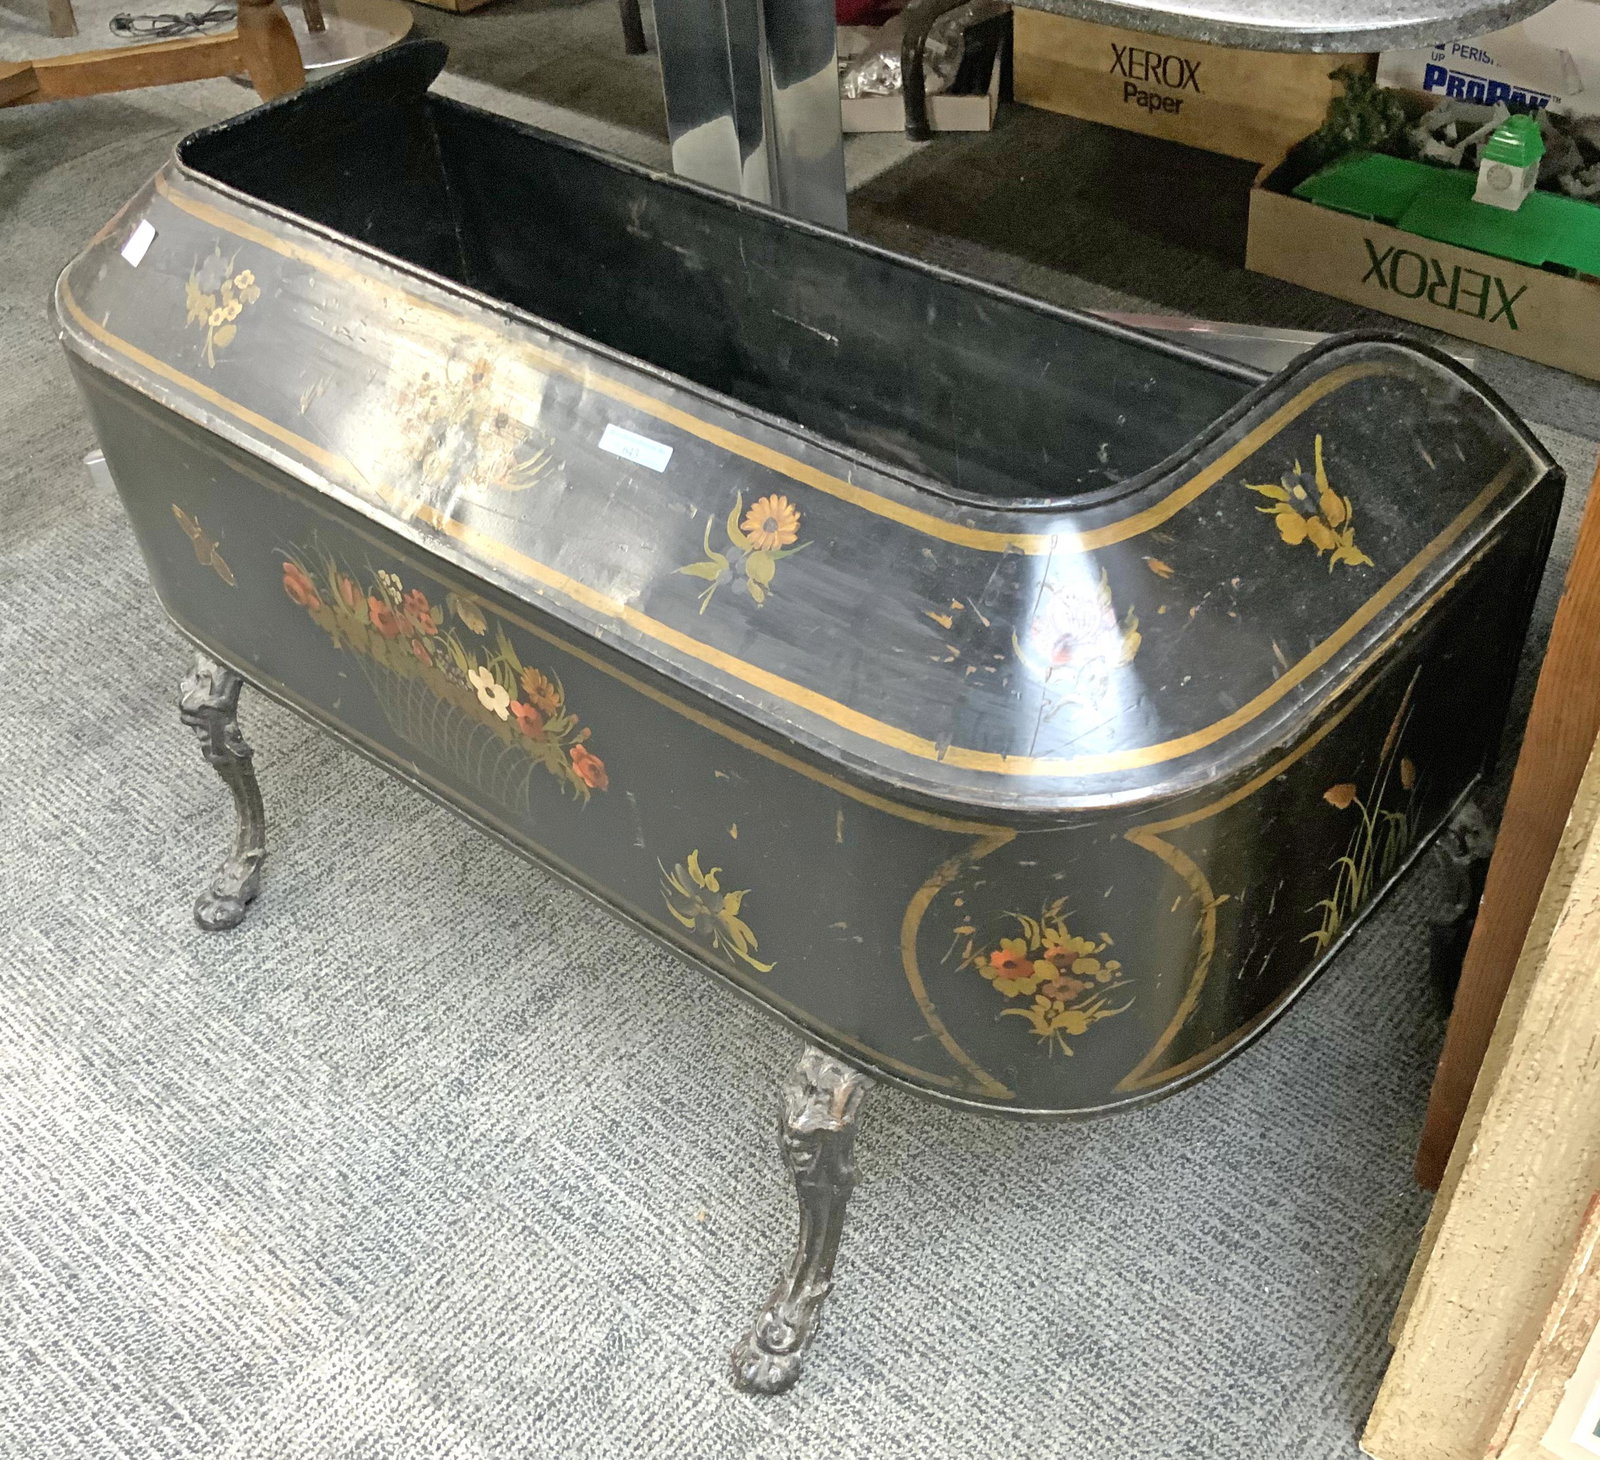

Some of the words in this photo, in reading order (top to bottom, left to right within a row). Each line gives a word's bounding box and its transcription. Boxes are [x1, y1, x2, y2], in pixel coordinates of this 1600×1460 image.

[1110, 43, 1201, 93] XEROX
[1431, 51, 1446, 62] UP
[1124, 81, 1183, 114] Paper
[1362, 238, 1528, 330] XEROX
